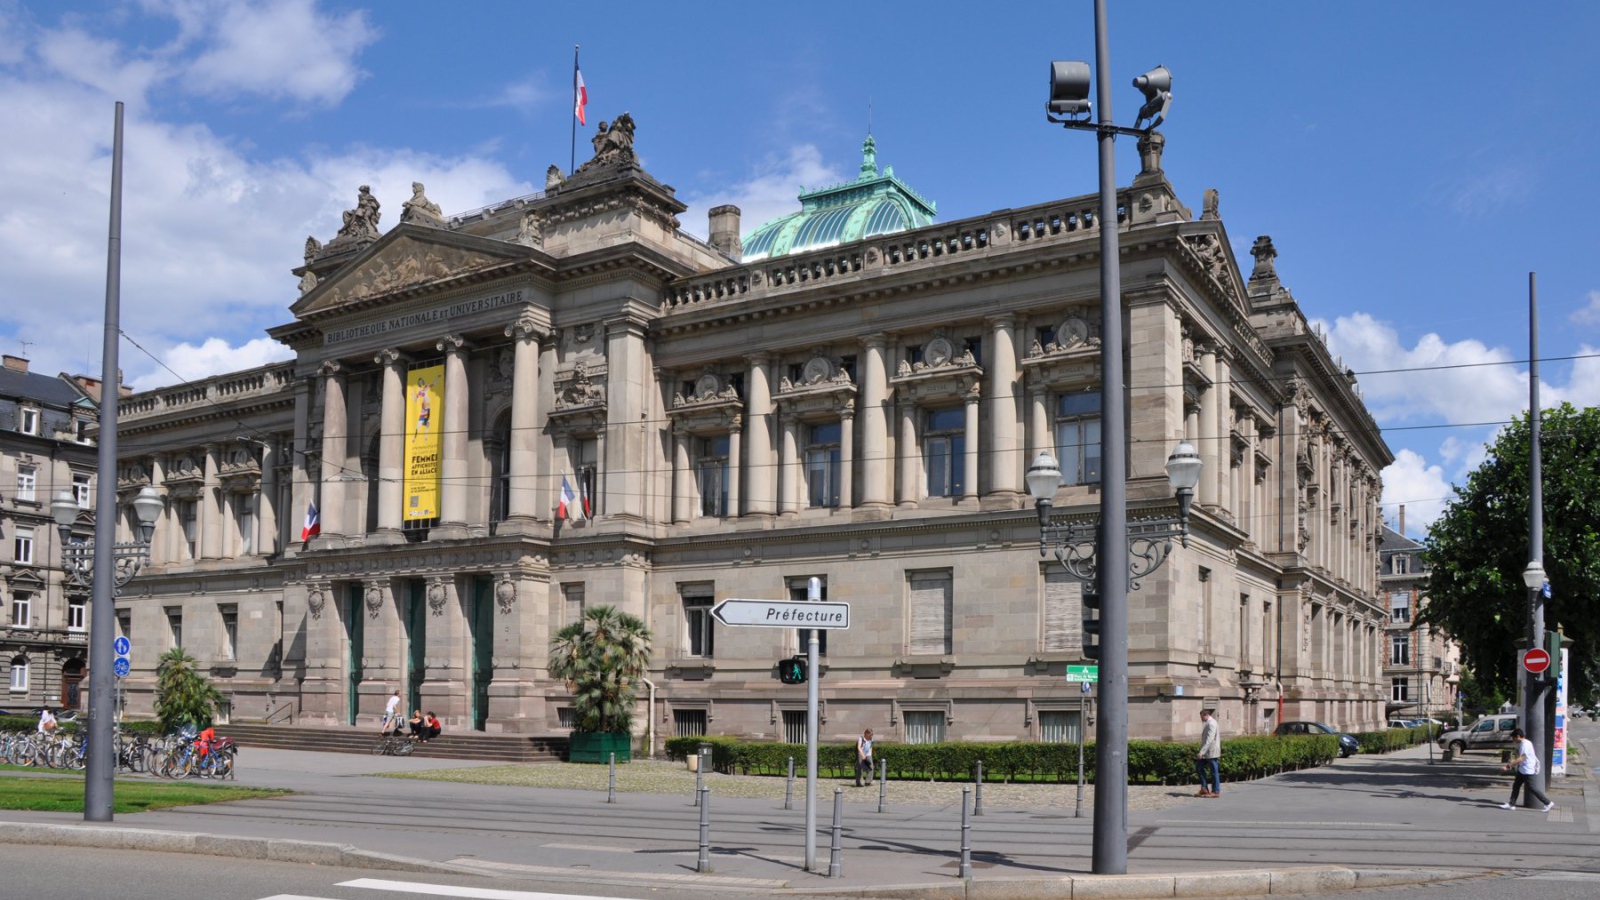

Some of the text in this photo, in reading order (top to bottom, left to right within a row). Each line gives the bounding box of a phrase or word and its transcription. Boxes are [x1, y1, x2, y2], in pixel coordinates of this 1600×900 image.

[328, 291, 523, 343] BIBLIOTHEQUE NATIONALE ET UNIVERSITAIRE
[412, 453, 438, 463] FEMMES
[419, 467, 437, 475] ALSACE
[766, 607, 843, 622] Préfecture
